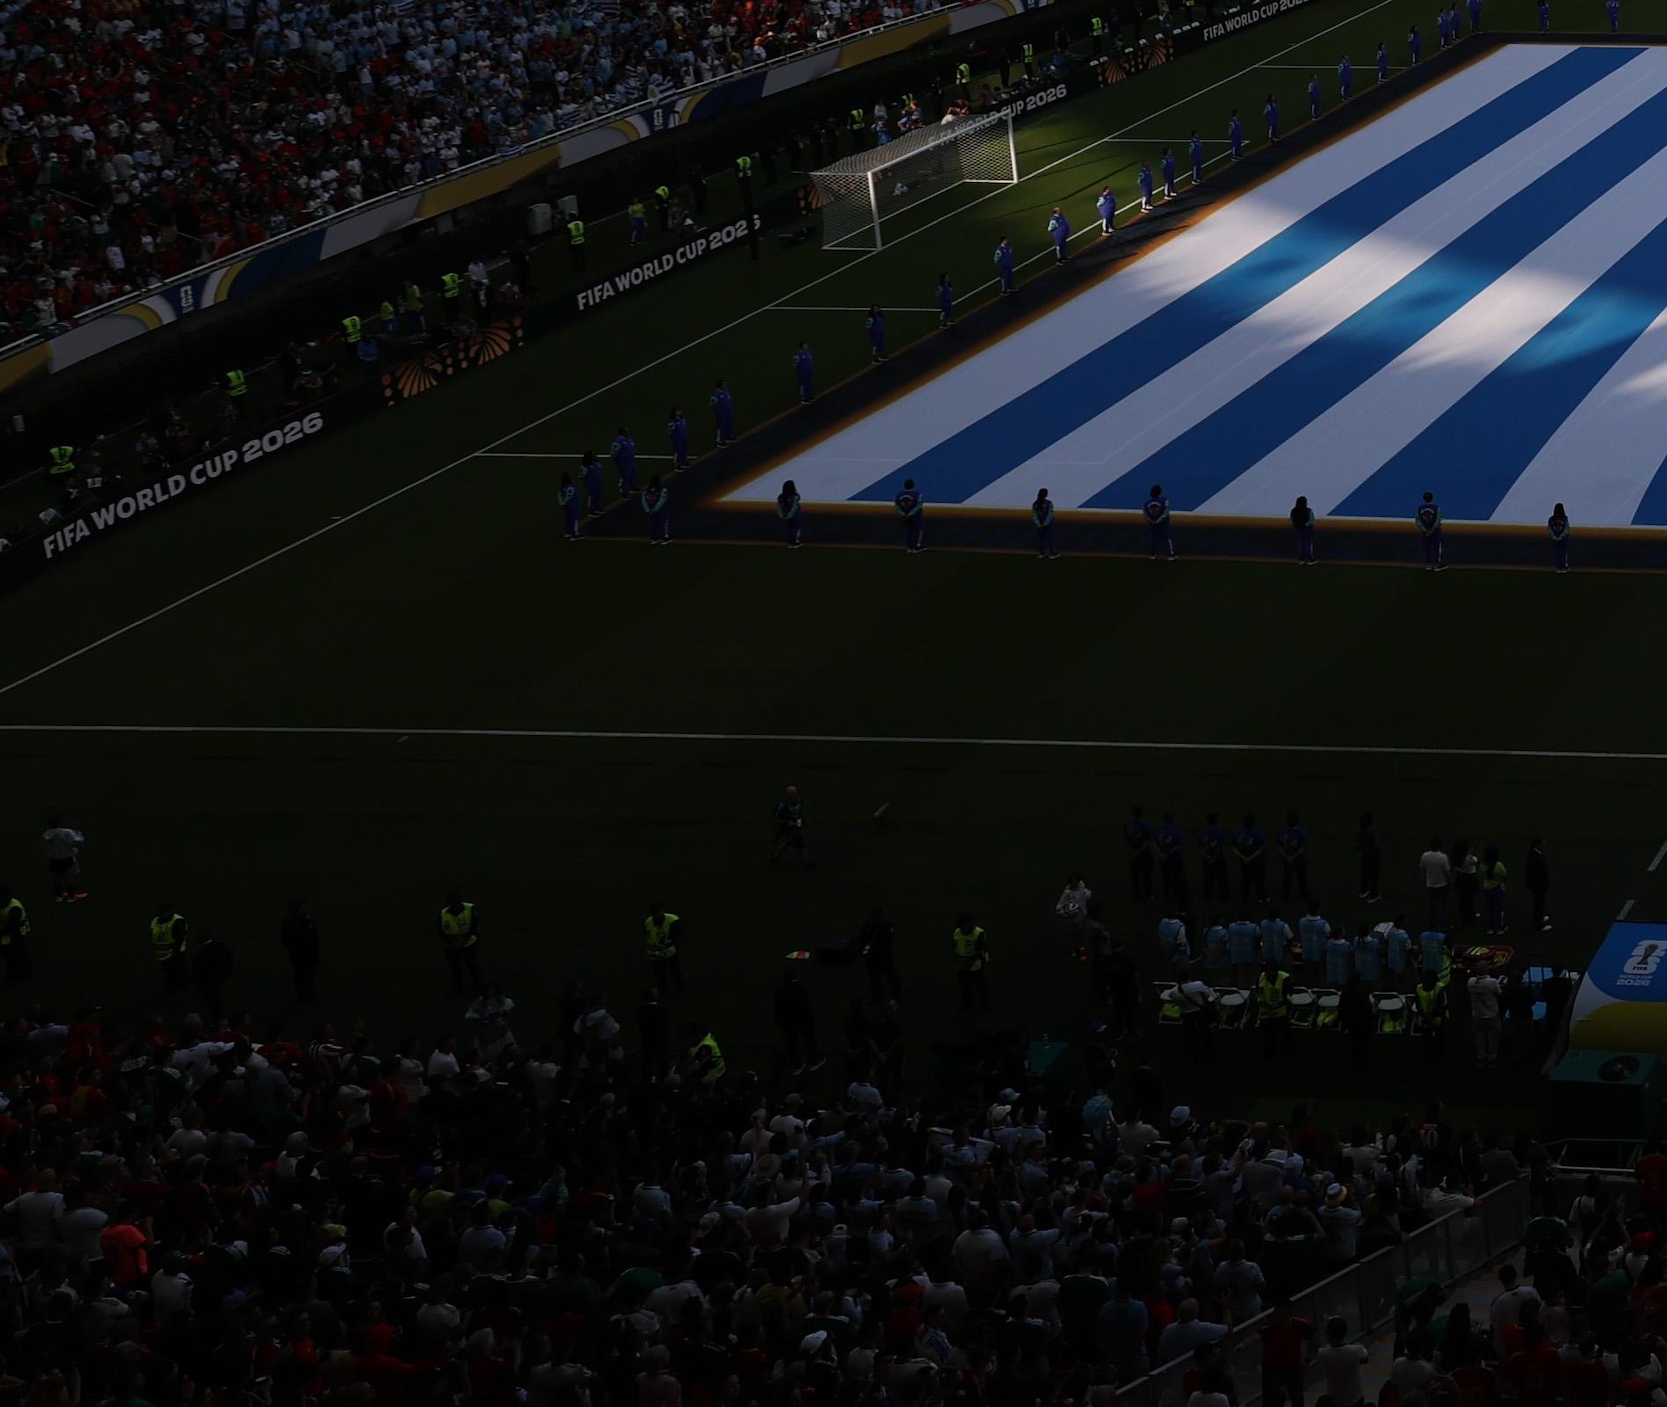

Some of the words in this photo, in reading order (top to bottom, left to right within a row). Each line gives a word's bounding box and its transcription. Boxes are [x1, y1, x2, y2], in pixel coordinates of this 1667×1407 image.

[1203, 23, 1225, 41] FIFA
[1225, 10, 1259, 32] WORLD
[1260, 2, 1279, 18] CUP
[1025, 84, 1068, 110] 2026
[576, 282, 616, 311] FIFA
[614, 255, 674, 292] WORLD
[676, 239, 707, 264] CUP
[42, 519, 92, 559] FIFA
[90, 475, 187, 530] WORLD
[189, 450, 239, 485] CUP
[241, 412, 324, 463] 2026
